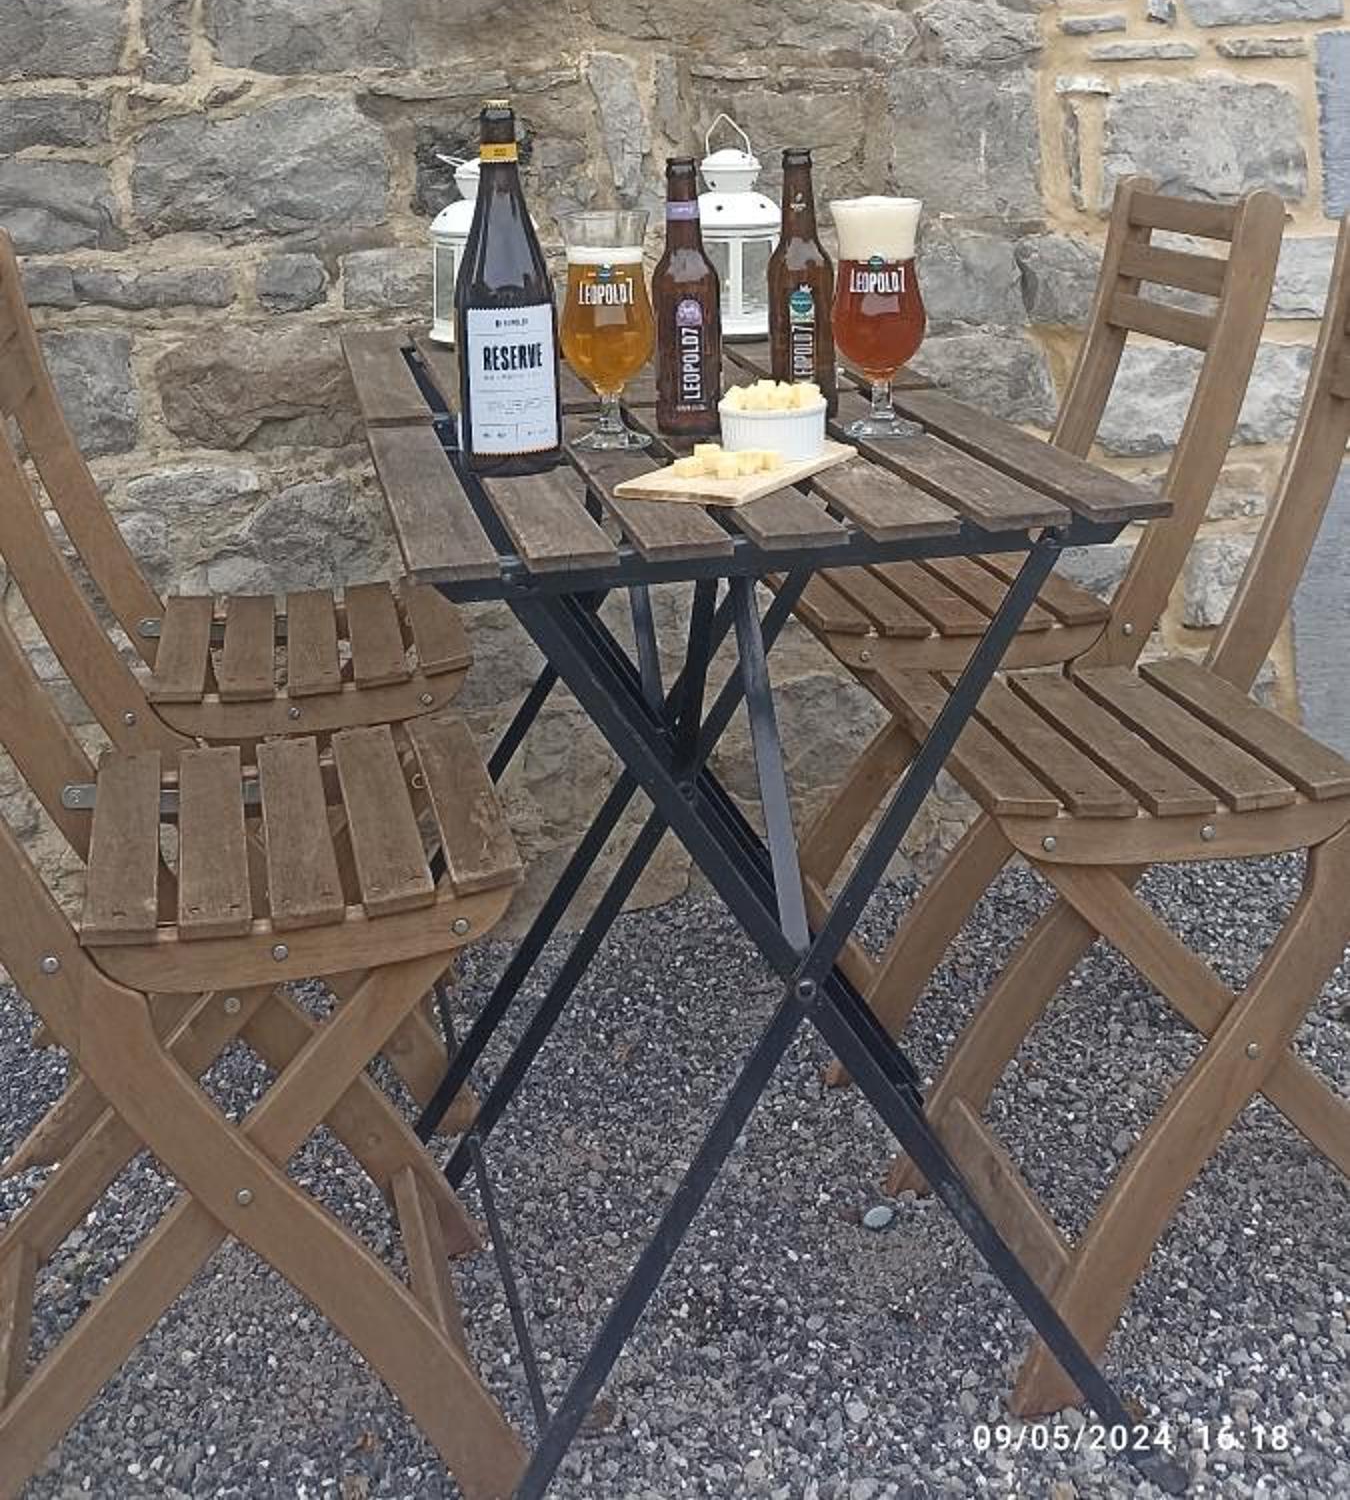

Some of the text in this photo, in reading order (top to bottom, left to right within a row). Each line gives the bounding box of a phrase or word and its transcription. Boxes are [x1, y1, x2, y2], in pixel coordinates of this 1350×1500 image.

[578, 277, 634, 305] LEOPOLD7
[849, 266, 905, 293] LEOPOLD7
[483, 342, 543, 371] RESERVE
[681, 327, 701, 400] LEOPOLD7
